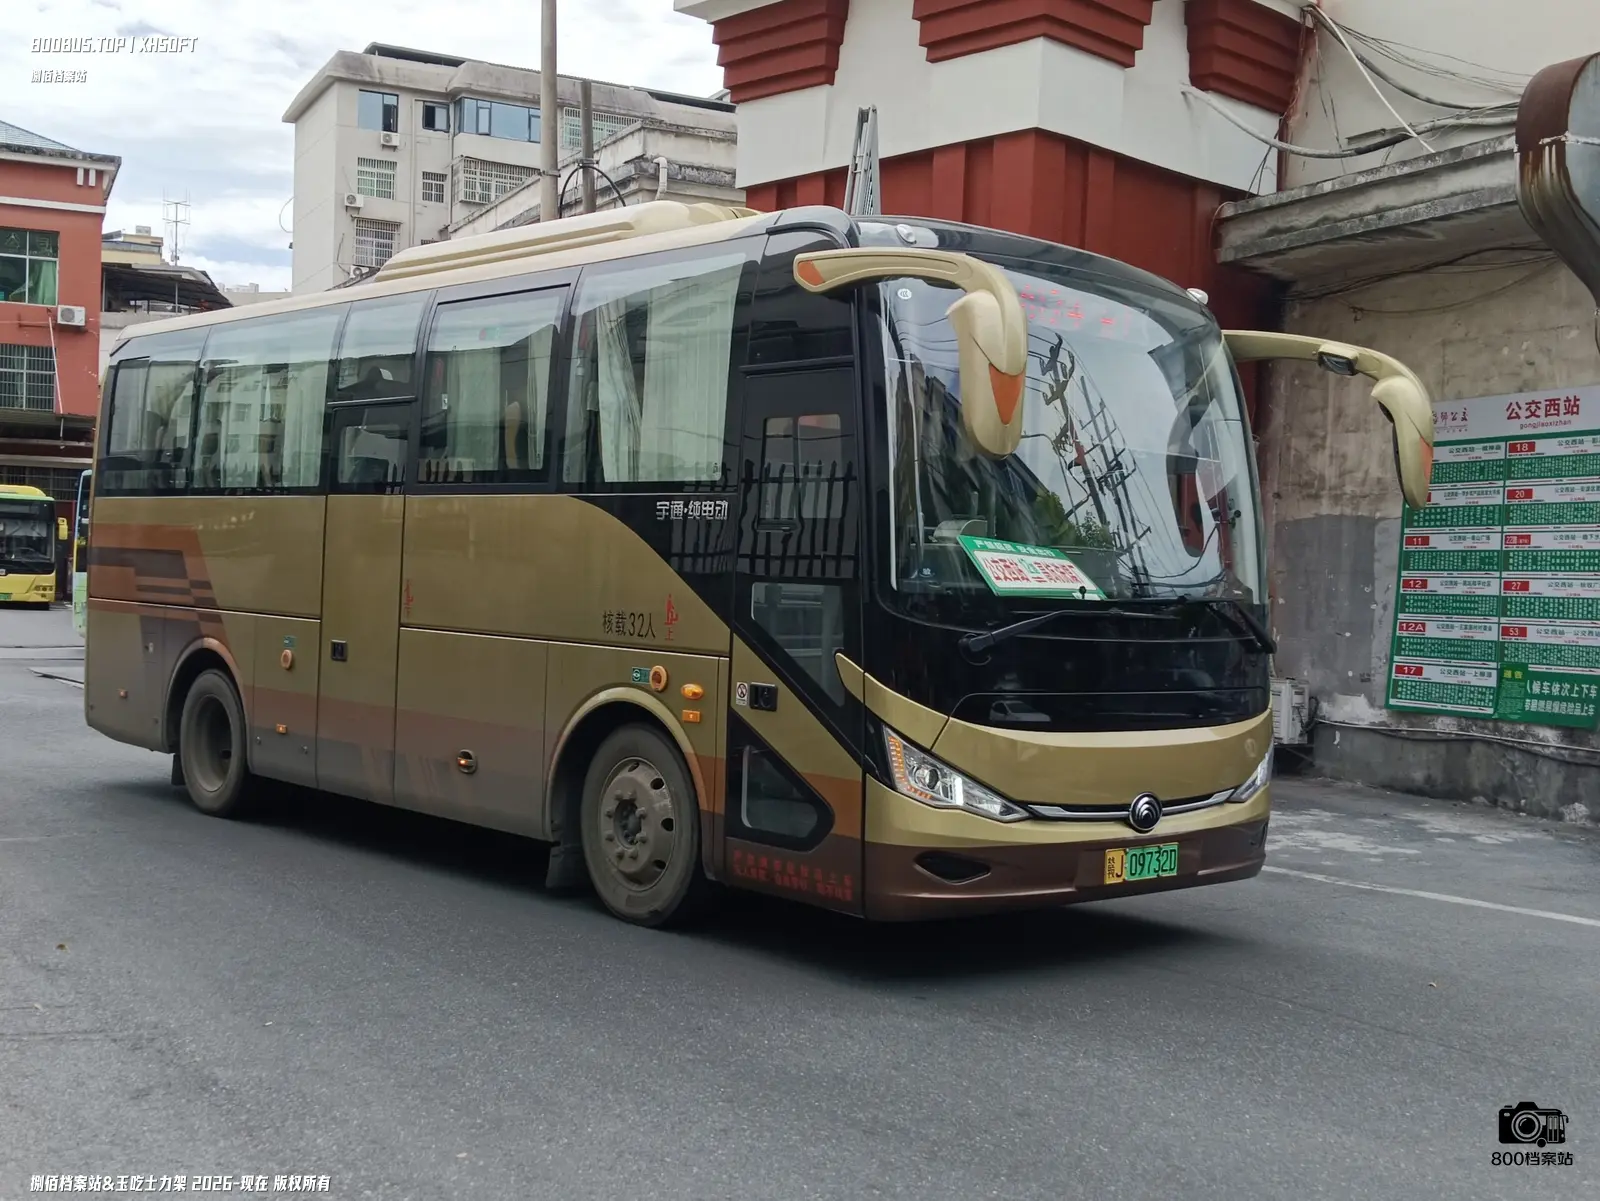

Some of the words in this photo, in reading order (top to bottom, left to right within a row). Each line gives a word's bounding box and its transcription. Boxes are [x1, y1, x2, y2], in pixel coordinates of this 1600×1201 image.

[1506, 395, 1581, 420] 公交西站
[1515, 443, 1529, 452] 18
[1514, 490, 1525, 499] 20
[1412, 537, 1422, 545] 11
[1409, 580, 1422, 588] 12
[1511, 581, 1521, 590] 27
[602, 610, 656, 639] 核载32人
[1402, 623, 1424, 631] 12A
[664, 628, 674, 641] 上
[1509, 627, 1519, 636] 53
[1403, 667, 1416, 675] 17
[1526, 680, 1598, 699] 候车依次上下车
